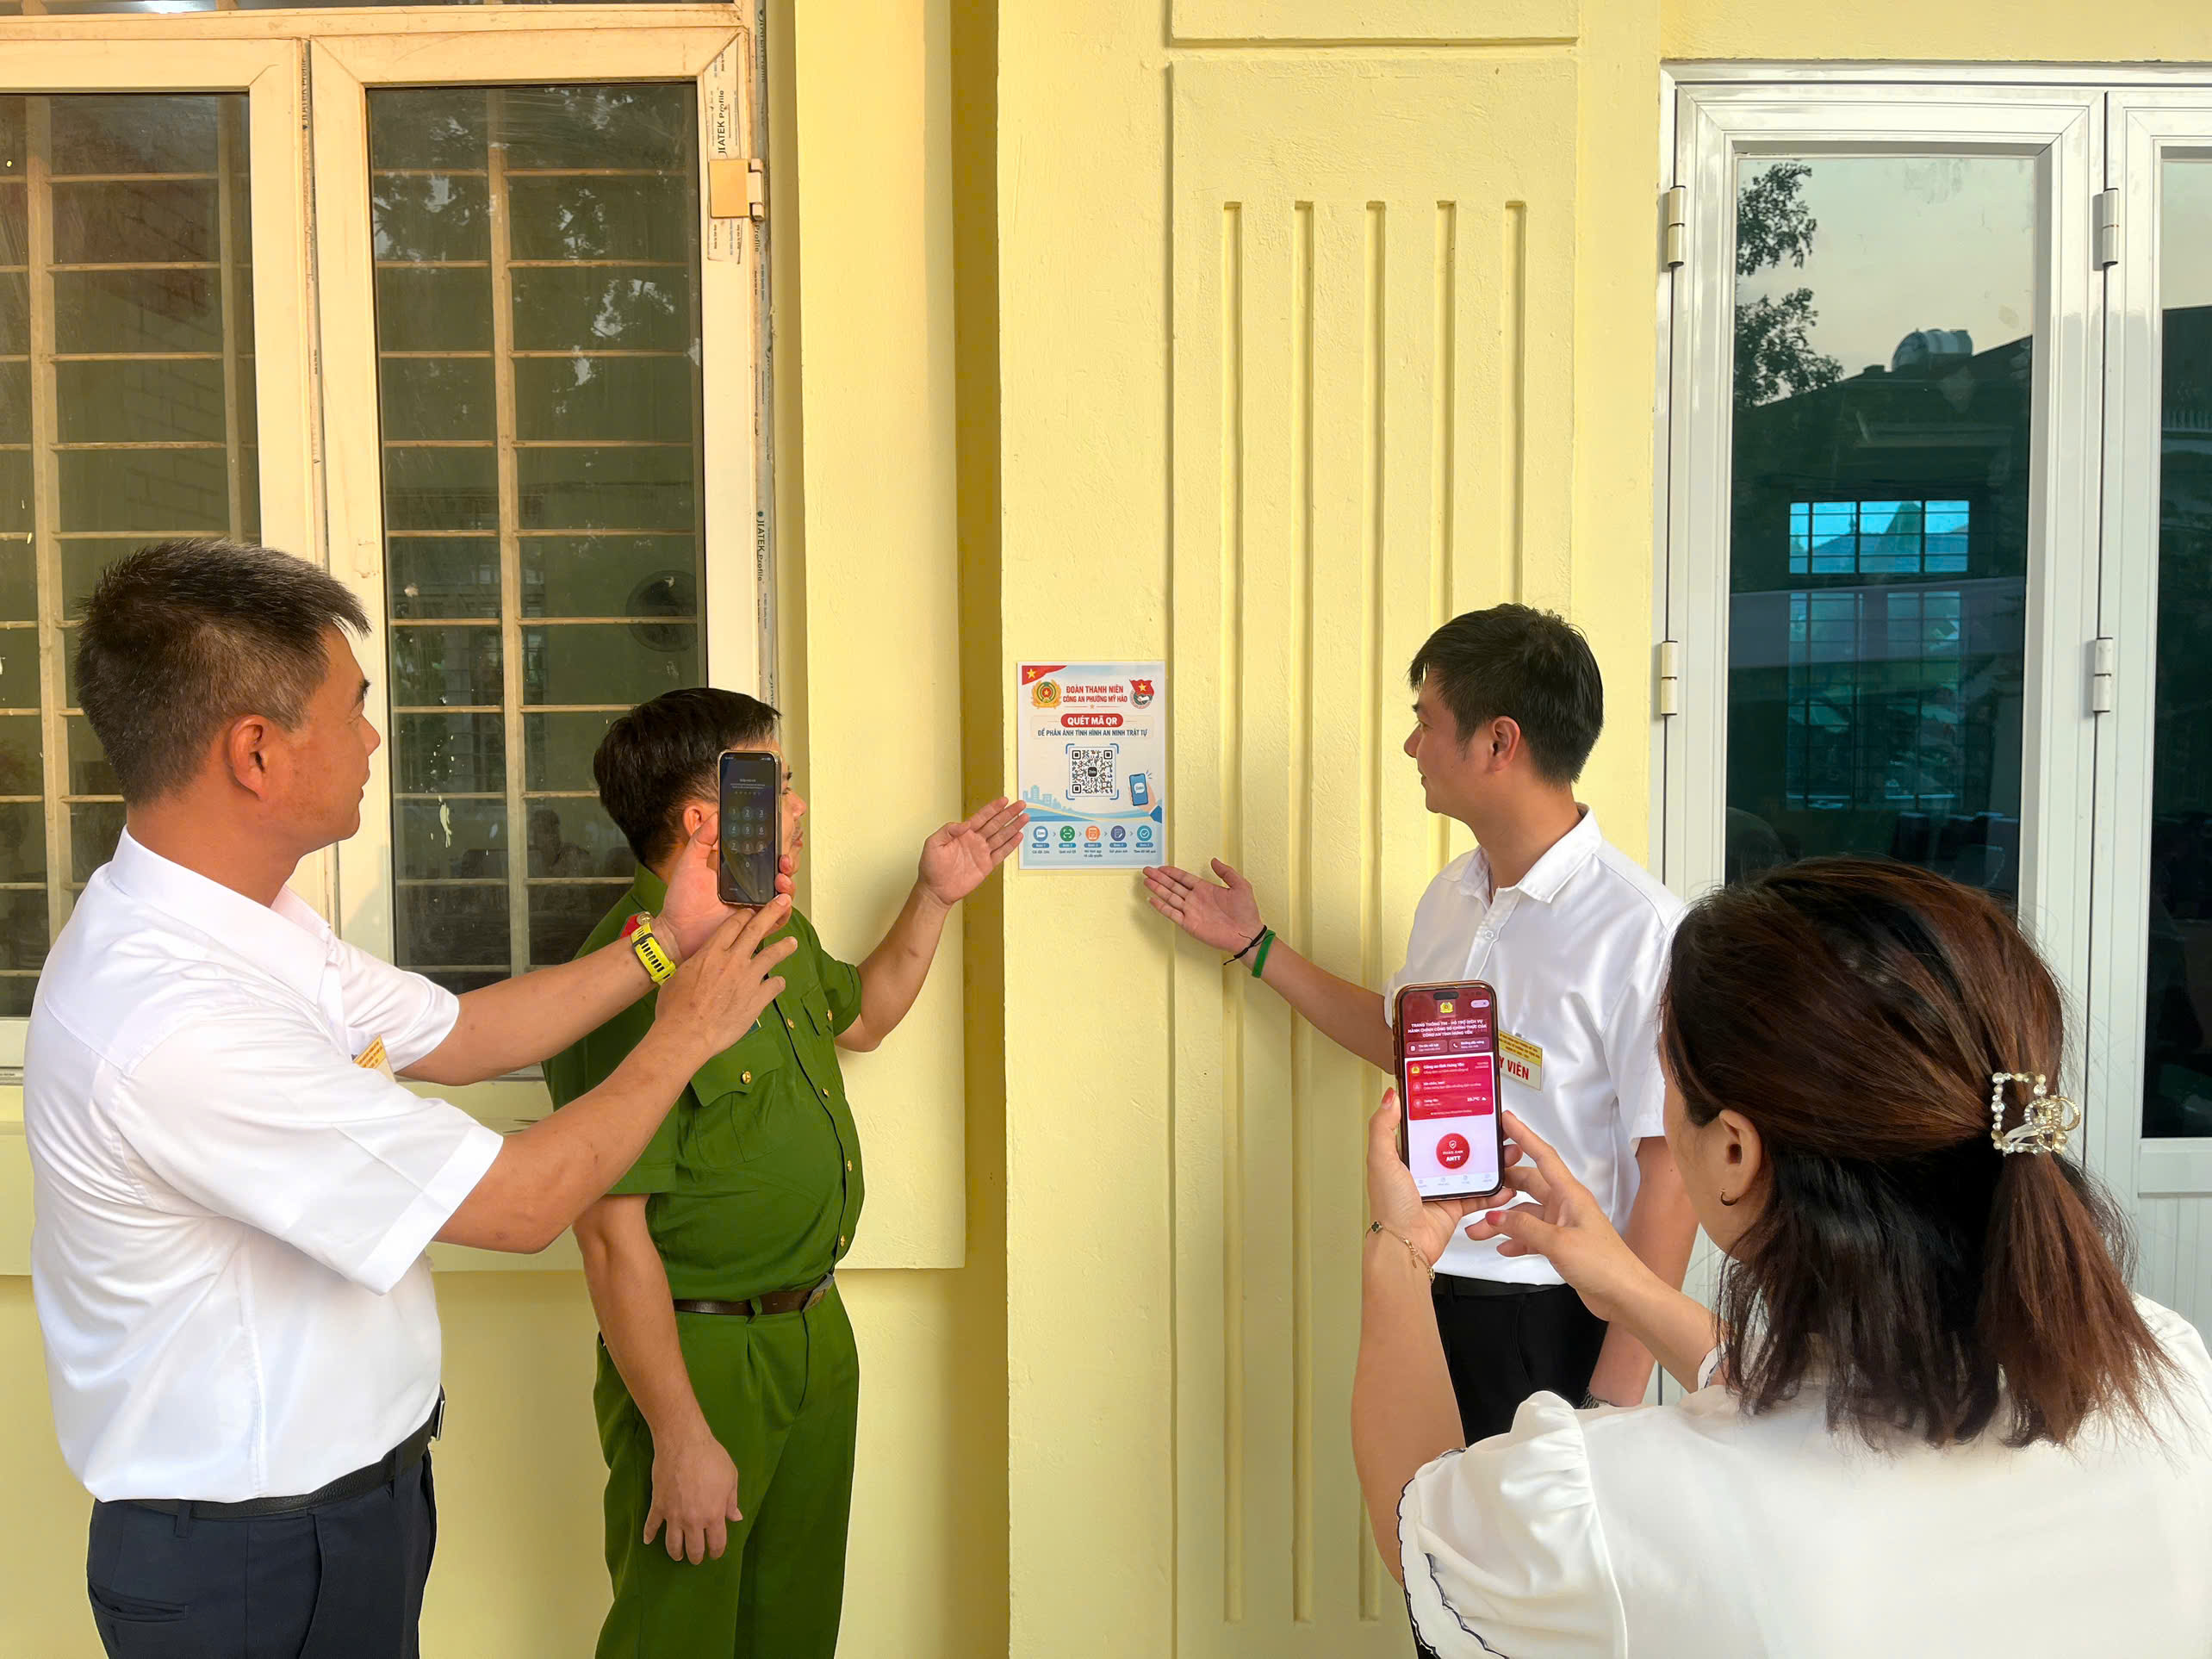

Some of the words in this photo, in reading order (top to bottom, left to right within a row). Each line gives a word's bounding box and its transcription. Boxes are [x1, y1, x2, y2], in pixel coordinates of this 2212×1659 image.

[718, 121, 726, 154] JIATEK
[756, 519, 765, 551] JIATEK
[1066, 684, 1084, 693] ĐOÀN
[1109, 684, 1123, 693] NIÊN
[1068, 715, 1090, 725] QUÉT
[1091, 715, 1104, 725] MÃ
[1106, 717, 1117, 726] QR
[1507, 1059, 1529, 1080] VIÊN
